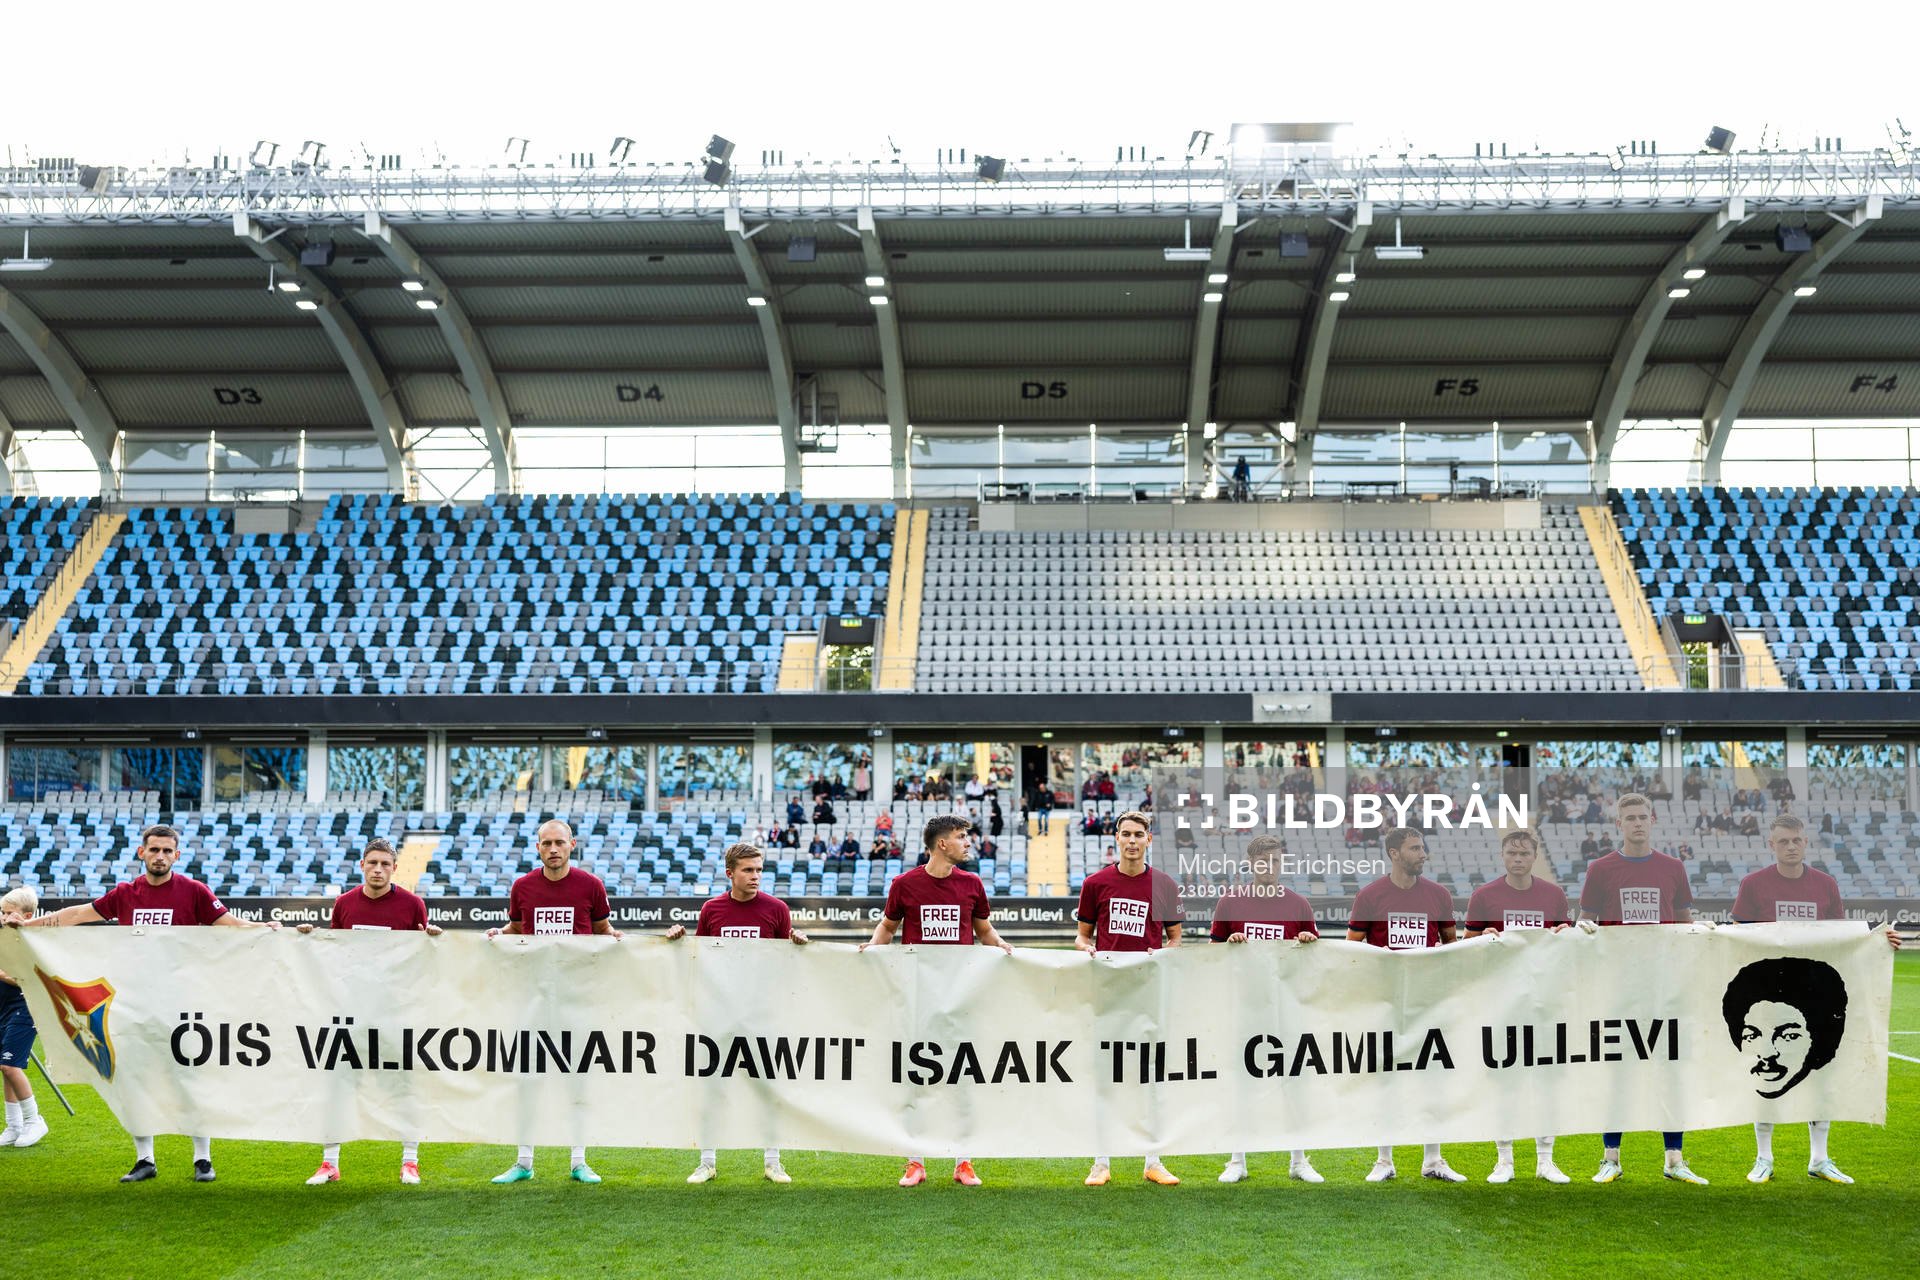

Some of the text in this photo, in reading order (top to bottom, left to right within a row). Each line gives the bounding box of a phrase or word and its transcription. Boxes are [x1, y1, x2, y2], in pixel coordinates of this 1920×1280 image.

[1022, 382, 1068, 399] D5
[1434, 379, 1479, 396] F5
[1850, 374, 1897, 393] F4
[214, 388, 262, 404] D3
[616, 384, 664, 402] D4
[1622, 891, 1658, 904] FREE
[270, 907, 319, 921] Gamla
[469, 907, 510, 921] Gaml
[620, 907, 662, 921] Ullevi
[669, 907, 701, 921] Gam
[789, 907, 816, 921] mla
[818, 907, 861, 921] Ullevi
[1021, 907, 1063, 922] Ullevi
[1185, 908, 1215, 921] aml
[923, 908, 958, 922] FREE
[1111, 901, 1146, 918] FREE
[1624, 909, 1659, 921] DAWIT
[1778, 904, 1815, 918] FREE
[135, 912, 171, 925] FREE
[536, 911, 572, 923] FREE
[1390, 915, 1425, 930] FREE
[1506, 913, 1542, 927] FREE
[923, 927, 958, 938] DAWIT
[1110, 920, 1144, 933] DAWIT
[1246, 926, 1282, 940] FREE
[1390, 934, 1426, 945] DAWIT
[171, 1013, 1678, 1085] ÖIS VÄLKOMNAR DAWIT ISAAK TILL GAMLA ULLEVI
